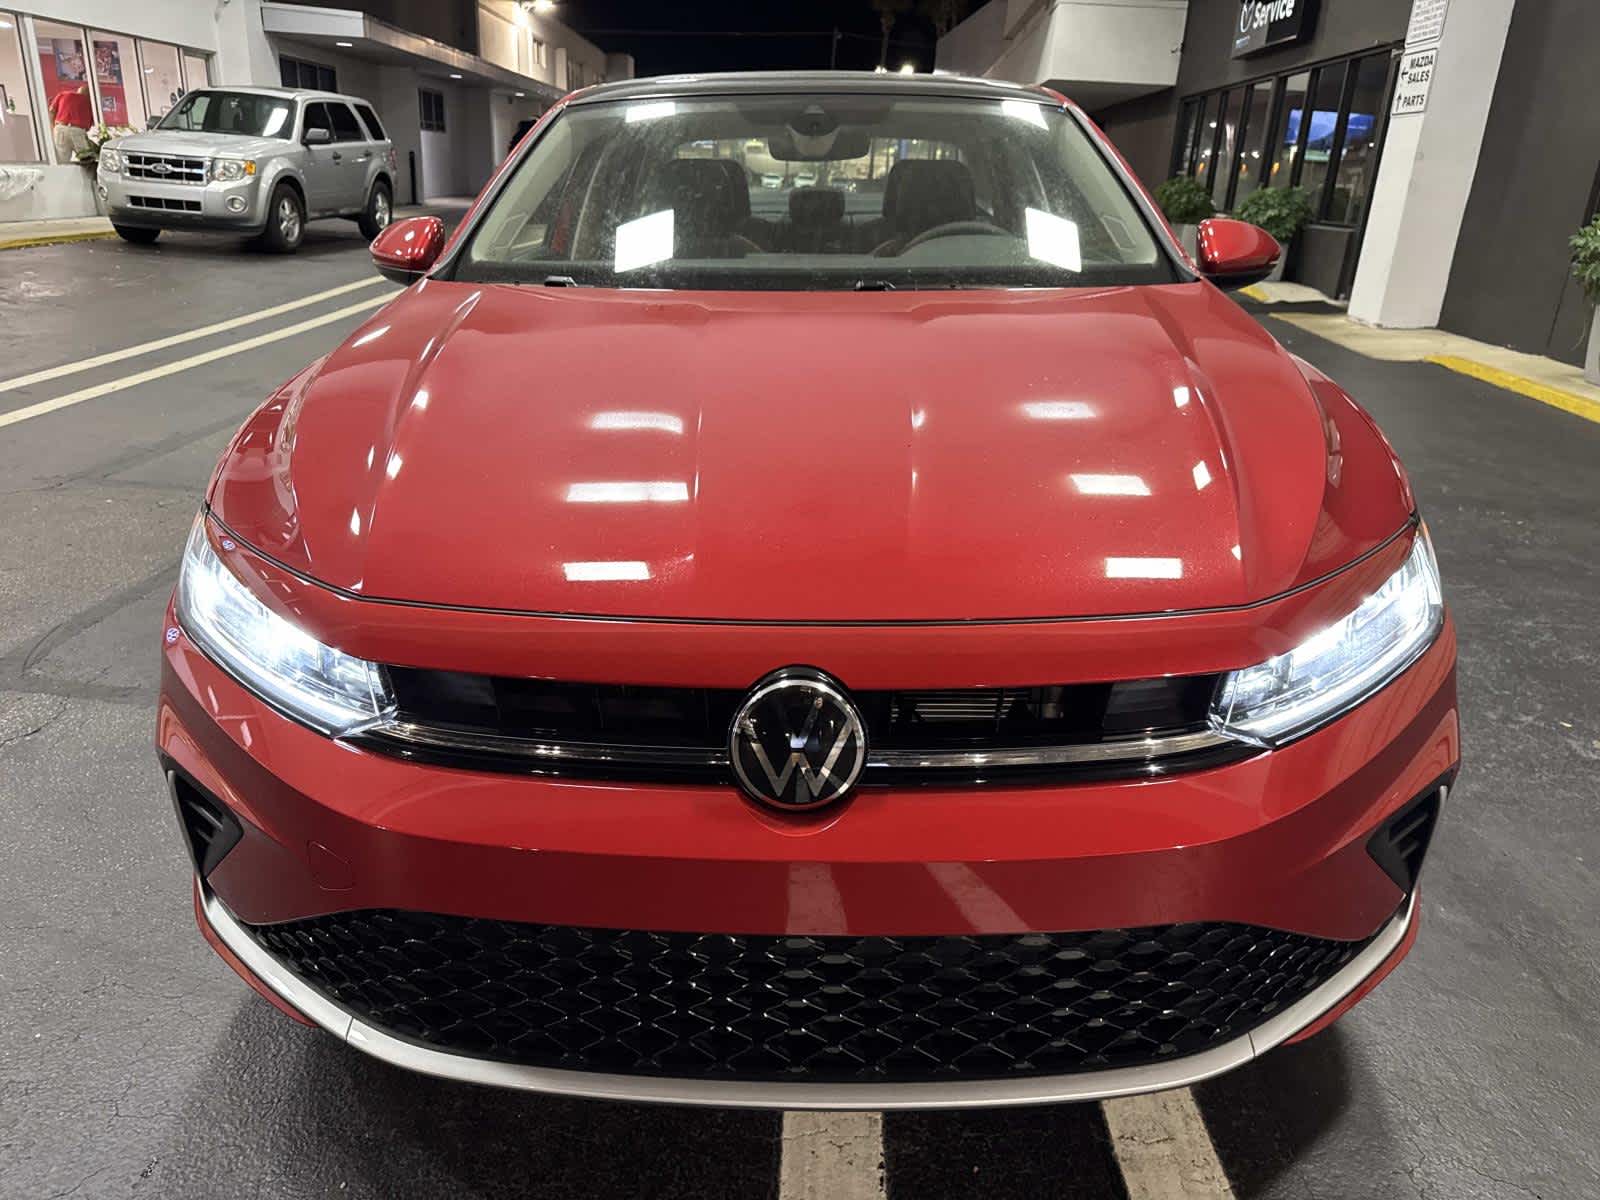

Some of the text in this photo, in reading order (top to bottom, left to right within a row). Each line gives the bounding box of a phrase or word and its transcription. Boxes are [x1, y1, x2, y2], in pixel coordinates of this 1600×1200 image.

[1252, 0, 1295, 29] Service
[1410, 55, 1433, 69] MAZDA
[1408, 70, 1430, 84] SALES
[1402, 95, 1425, 107] PARTS
